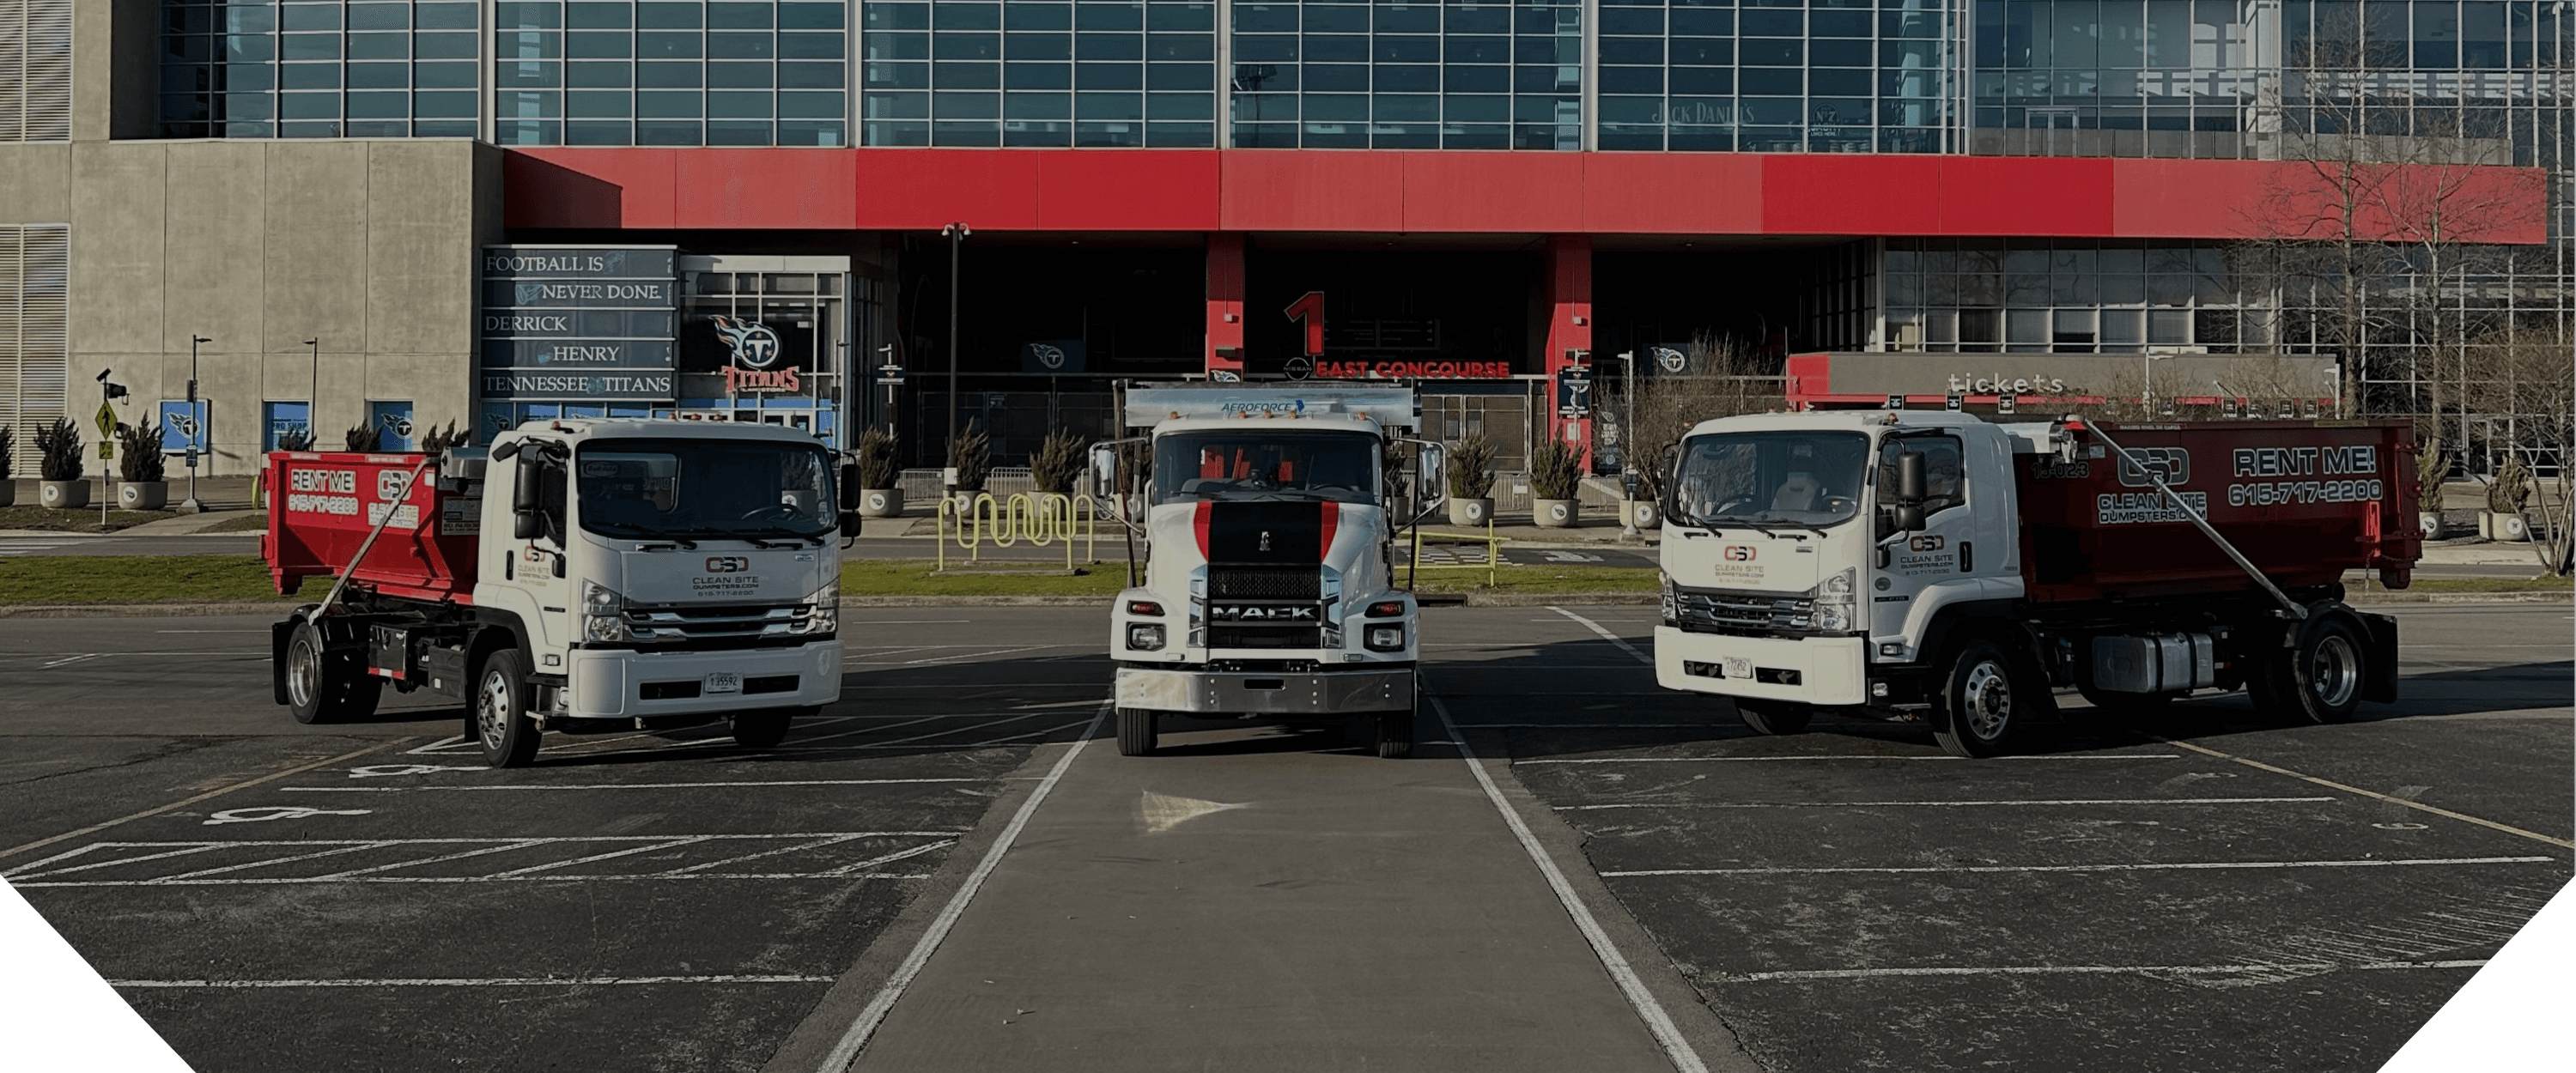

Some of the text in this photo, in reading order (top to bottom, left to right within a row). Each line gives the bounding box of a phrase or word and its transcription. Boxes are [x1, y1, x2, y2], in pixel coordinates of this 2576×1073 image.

[1696, 102, 1754, 124] DANIL'S
[485, 257, 604, 272] FOOTBALL IS
[542, 285, 662, 300] NEVER DONE.
[485, 316, 568, 331] DERRICK
[1284, 290, 1324, 356] 1
[553, 346, 620, 361] HENRY
[1315, 361, 1511, 379] EAST CONCOURSE
[483, 376, 671, 392] TENNESSEE TITANS
[720, 365, 800, 393] TITANS
[1947, 372, 2064, 393] tickets
[1221, 403, 1291, 412] AEROFORCE
[2233, 446, 2377, 477] RENT ME!
[291, 469, 328, 492] RENT
[2227, 479, 2384, 506] 615-717-2200
[2097, 493, 2163, 512] CLEAN
[2099, 509, 2208, 524] DUMPSTERS.CM
[1934, 554, 1953, 562] SITE
[1715, 564, 1765, 573] CLEAN SITE
[1212, 606, 1315, 619] MACK
